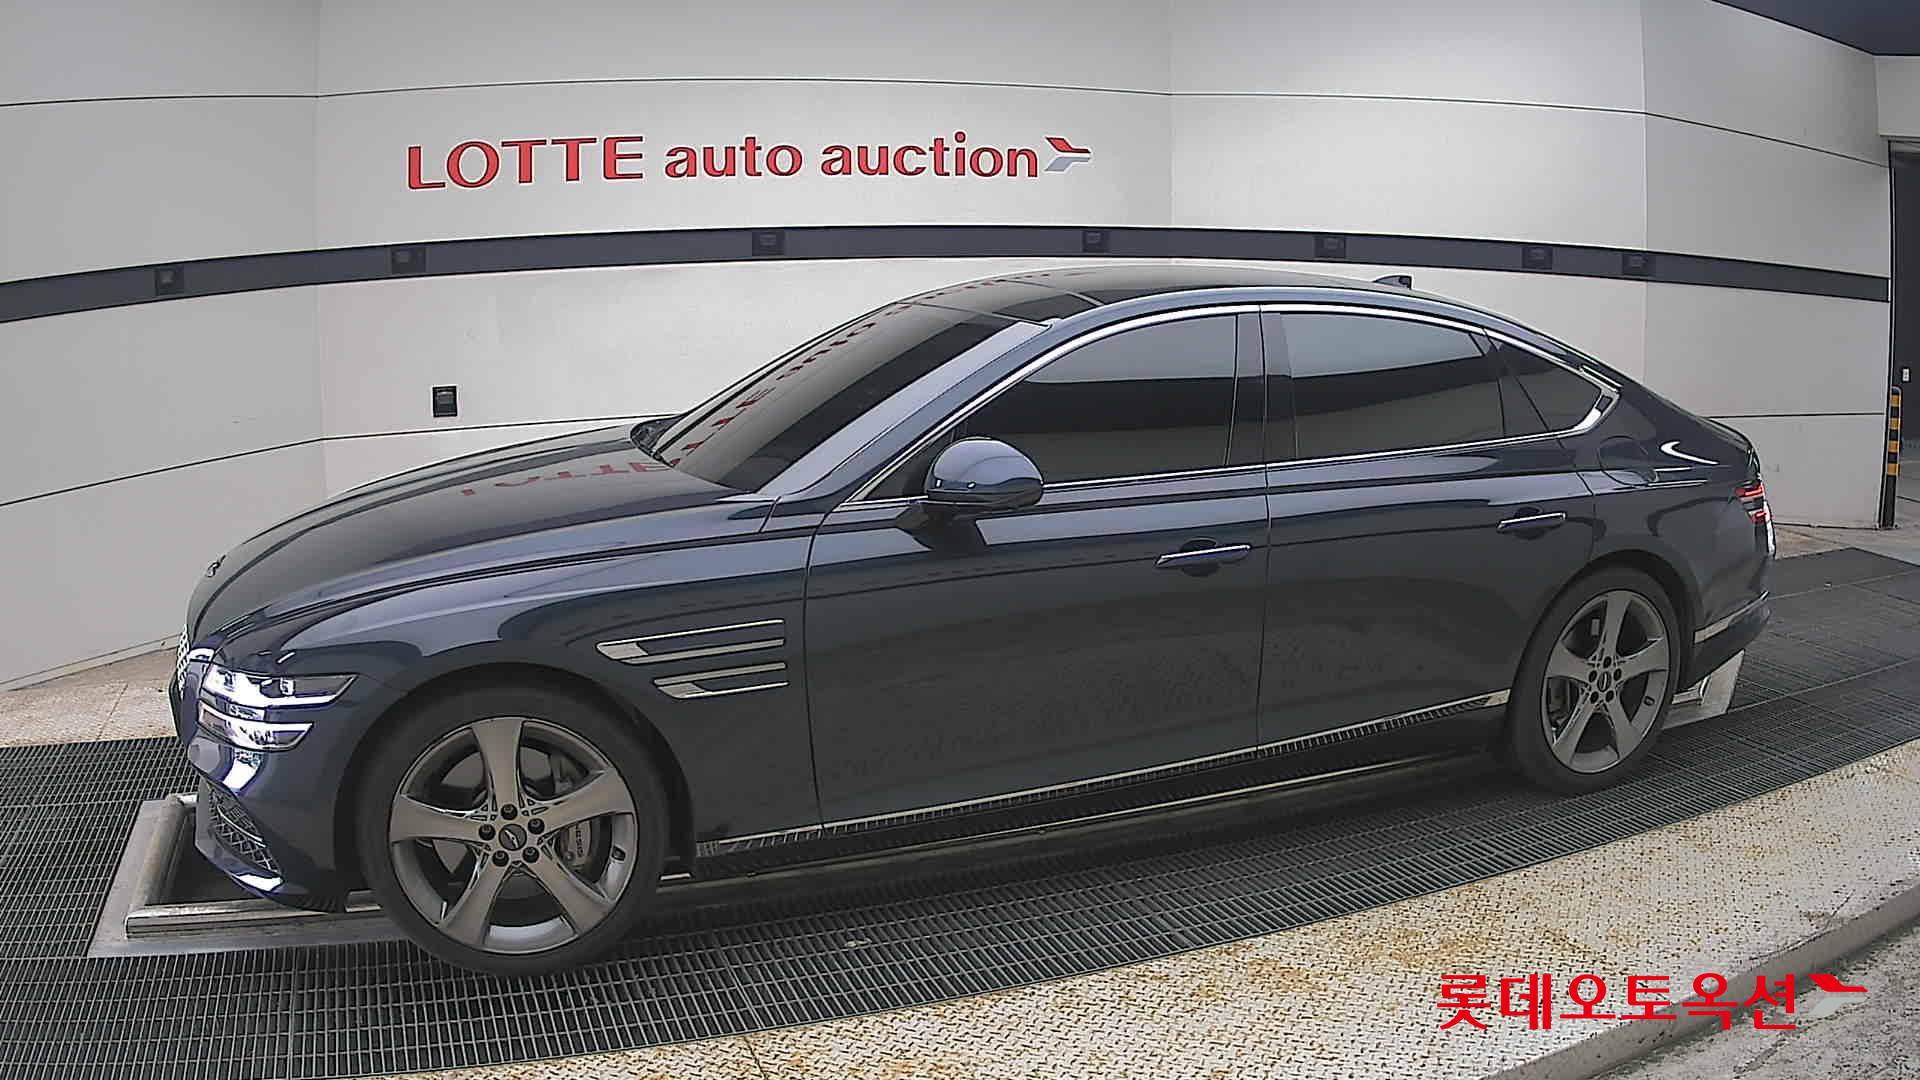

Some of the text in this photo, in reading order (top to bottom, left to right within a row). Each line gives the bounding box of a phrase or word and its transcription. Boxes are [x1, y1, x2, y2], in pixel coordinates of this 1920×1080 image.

[407, 131, 1038, 190] LOTTE auto auction
